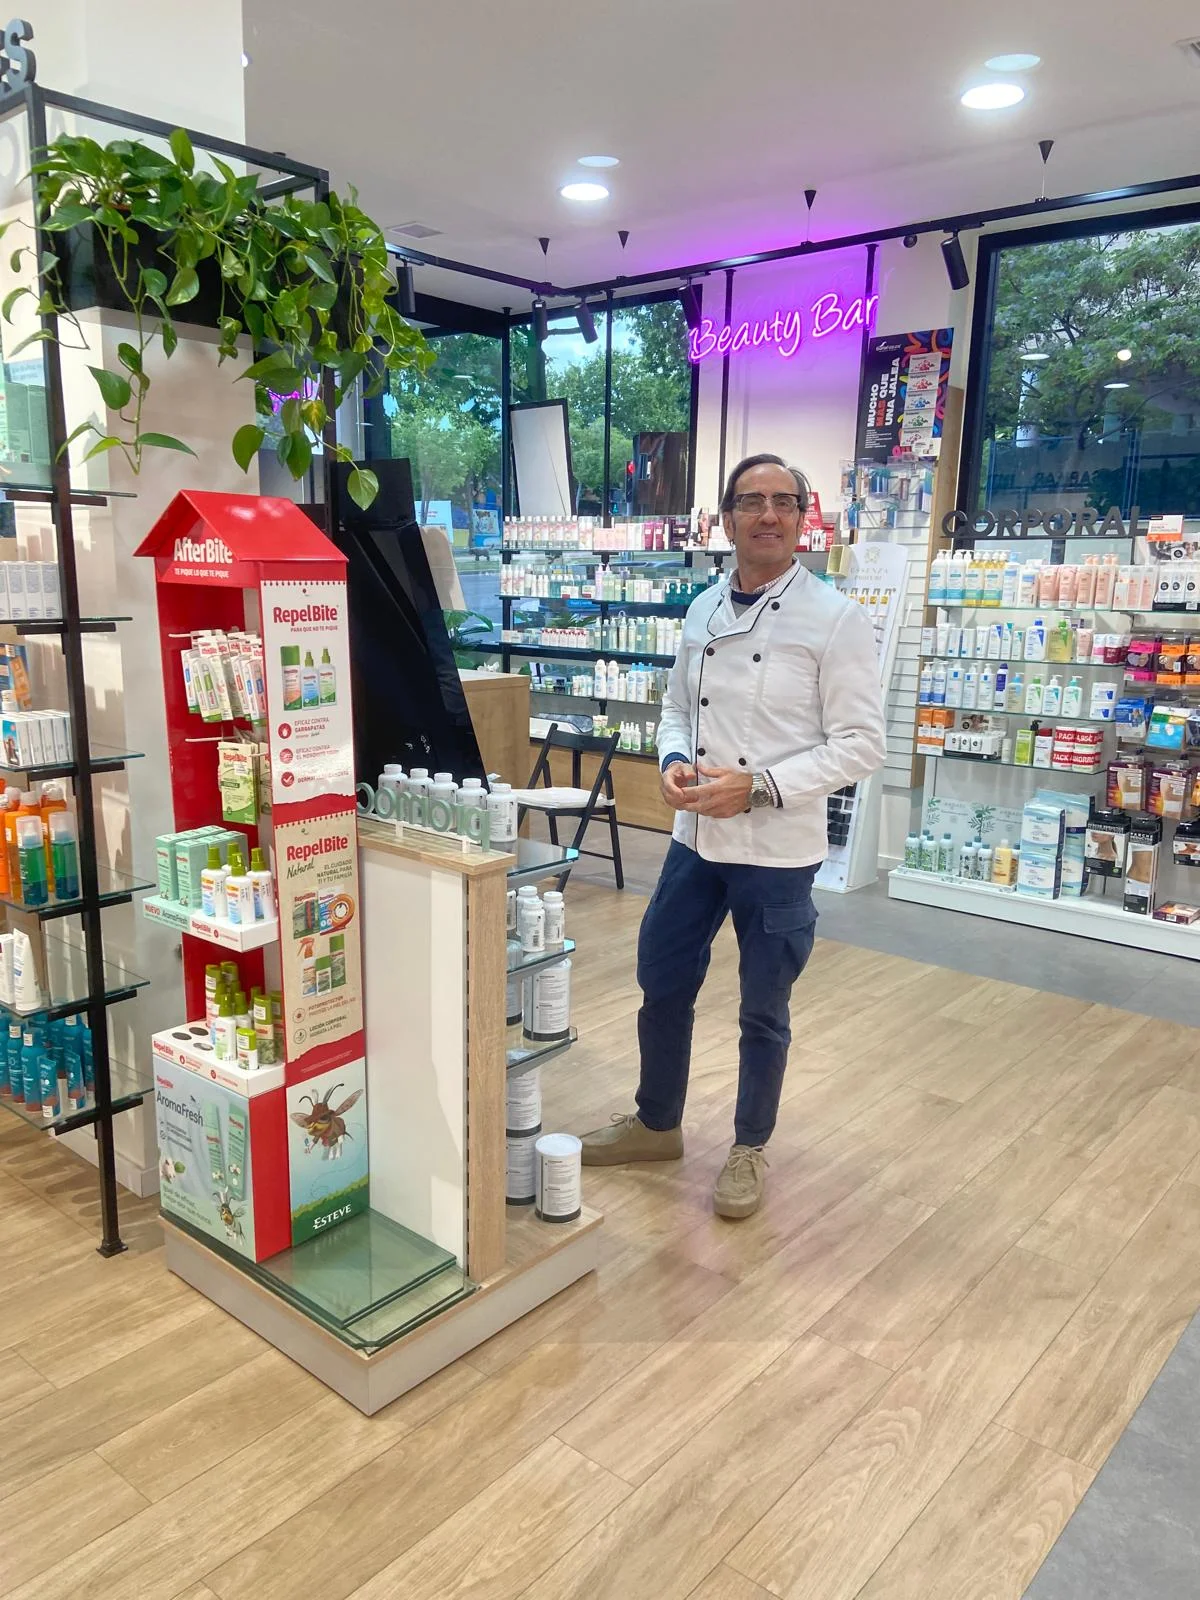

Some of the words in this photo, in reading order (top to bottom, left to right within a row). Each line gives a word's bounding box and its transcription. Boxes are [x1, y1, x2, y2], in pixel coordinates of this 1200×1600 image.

[690, 310, 801, 361] Beauty
[811, 293, 880, 338] Bar
[879, 373, 890, 398] QUE
[889, 357, 900, 398] JALEA
[867, 383, 879, 427] MUCHO
[885, 399, 896, 426] UNA
[941, 506, 1149, 538] CORPORAL
[173, 537, 233, 564] AfterBite
[273, 605, 338, 626] RepelBite
[287, 836, 348, 861] RepelBite
[287, 857, 314, 880] Natural
[317, 868, 338, 878] NATURAL
[156, 1090, 204, 1127] AromaFresh
[312, 1203, 352, 1230] ESTEVE
